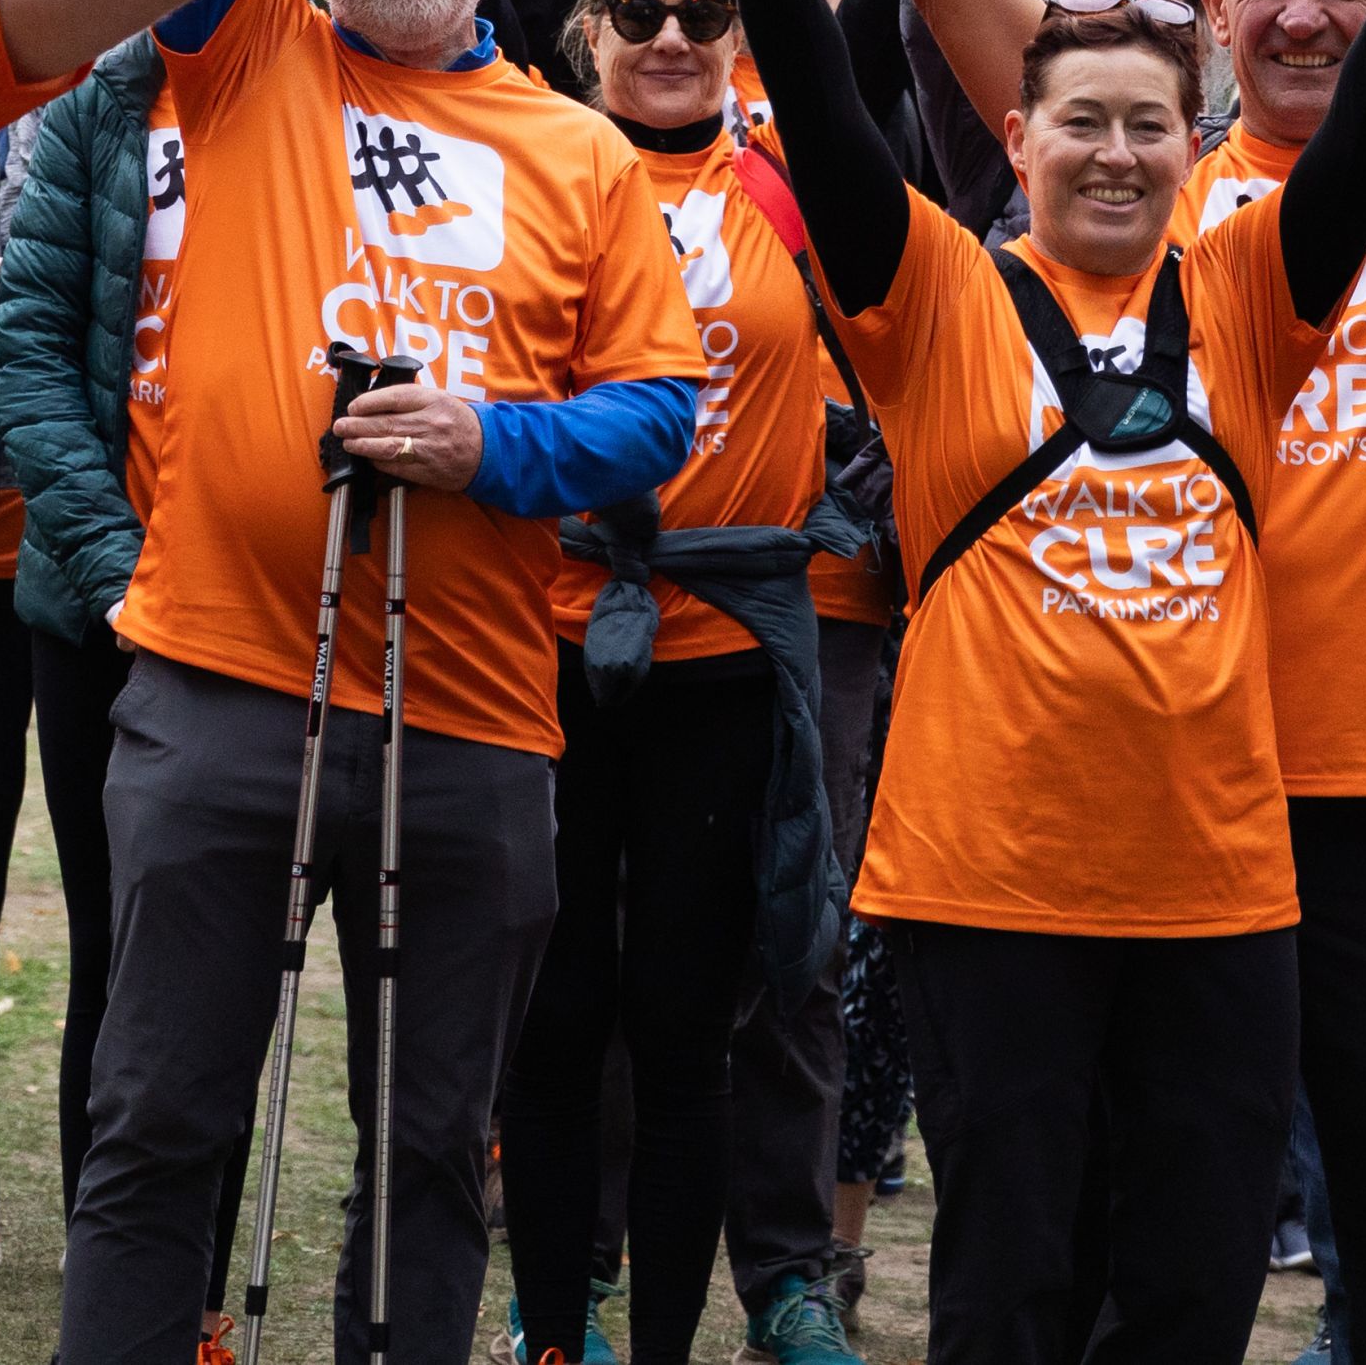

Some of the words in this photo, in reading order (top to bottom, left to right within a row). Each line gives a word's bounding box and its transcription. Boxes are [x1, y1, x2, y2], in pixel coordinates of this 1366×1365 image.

[434, 279, 496, 327] TO
[696, 320, 739, 359] O
[1020, 479, 1158, 522] WALK
[1162, 472, 1223, 517] TO
[1028, 519, 1225, 591] CURE
[1041, 587, 1220, 622] PARKINSON'S
[313, 641, 328, 703] WALKER
[383, 648, 393, 710] WALKER
